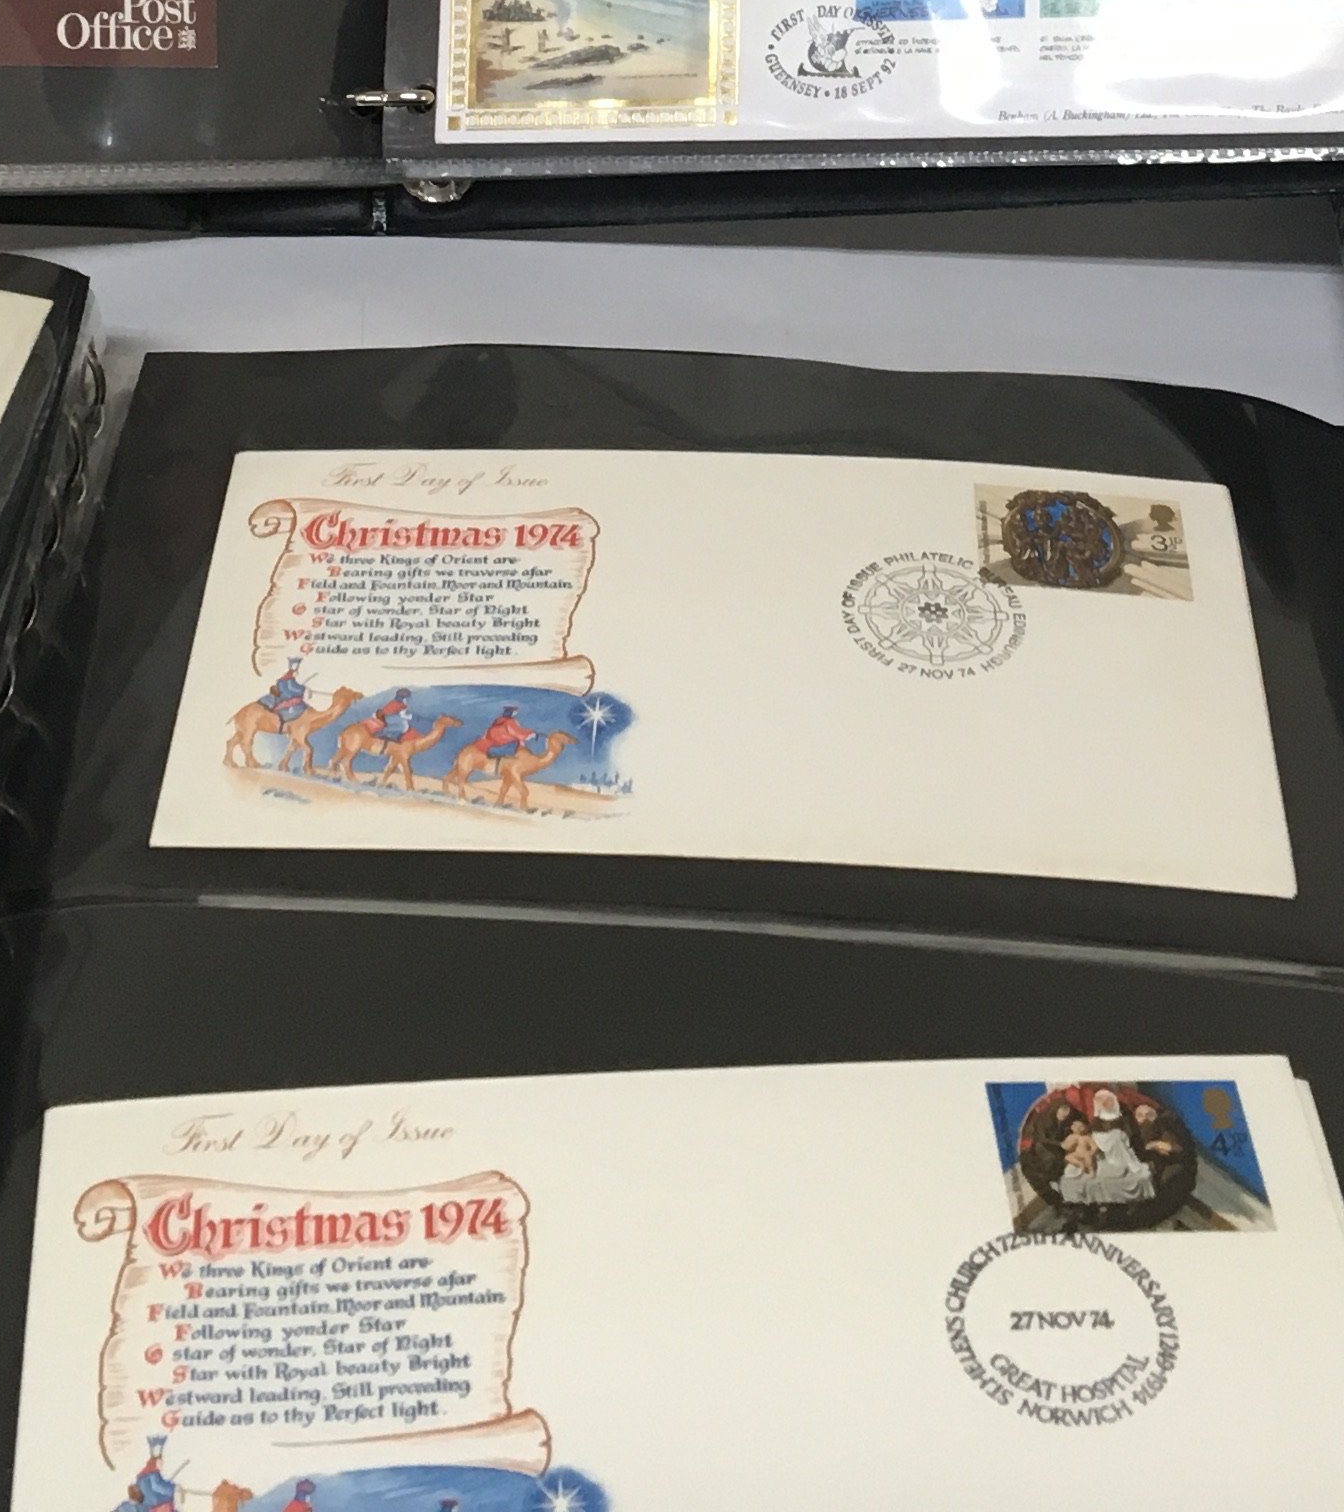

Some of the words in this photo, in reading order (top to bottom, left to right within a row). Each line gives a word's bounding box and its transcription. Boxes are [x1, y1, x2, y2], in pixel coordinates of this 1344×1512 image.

[57, 13, 173, 50] Office
[771, 8, 805, 41] FIRST
[818, 6, 841, 18] DAY
[765, 52, 822, 99] GUERNSEY
[835, 85, 848, 99] 18
[851, 71, 883, 96] SEPT
[321, 462, 385, 488] First
[394, 463, 452, 494] Day
[457, 472, 485, 495] of
[493, 465, 549, 487] Issue
[302, 510, 504, 551] Christmas
[516, 523, 582, 547] 1974
[883, 552, 974, 570] PHILATELIC
[850, 562, 882, 592] ISSUE
[841, 591, 857, 608] OF
[841, 610, 861, 635] DAY
[854, 637, 894, 667] FIRST
[897, 663, 917, 674] 27
[920, 669, 954, 679] NOV
[958, 667, 976, 677] 74
[163, 1112, 243, 1155] First
[257, 1110, 330, 1162] Day
[339, 1119, 373, 1160] of
[381, 1108, 454, 1142] Issue
[145, 1192, 411, 1255] Christmas
[421, 1197, 506, 1239] 1974
[159, 1261, 192, 1279] We
[200, 1263, 244, 1278] three
[252, 1261, 304, 1278] Kings
[310, 1258, 326, 1276] of
[332, 1256, 392, 1273] Orient
[399, 1257, 433, 1270] are
[945, 1241, 1001, 1313] CHURCH
[1059, 1231, 1178, 1331] ANNIVERSARY
[184, 1282, 270, 1300] Bearing
[277, 1280, 320, 1301] gifts
[326, 1283, 350, 1292] we
[356, 1276, 433, 1291] traverse
[437, 1271, 476, 1290] afar
[148, 1304, 198, 1321] Field
[203, 1304, 237, 1318] and
[337, 1298, 382, 1316] Moor
[384, 1295, 415, 1310] and
[420, 1290, 506, 1310] Mountain
[1010, 1311, 1035, 1330] 27
[1038, 1311, 1087, 1329] NOV
[175, 1324, 272, 1342] Following
[281, 1320, 350, 1342] yonder
[359, 1317, 407, 1333] Star
[144, 1344, 163, 1364] O
[172, 1345, 213, 1361] star
[219, 1345, 236, 1362] of
[323, 1339, 365, 1355] Star
[371, 1342, 388, 1356] of
[396, 1334, 453, 1352] Night
[172, 1364, 218, 1384] Star
[225, 1366, 267, 1379] with
[274, 1362, 327, 1381] Royal
[336, 1360, 400, 1375] beauty
[409, 1354, 471, 1374] Bright
[990, 1353, 1056, 1401] GREAT
[1062, 1354, 1150, 1403] HOSPITAL
[137, 1388, 242, 1407] Westward
[332, 1381, 373, 1400] Still
[161, 1409, 225, 1432] Guide
[261, 1411, 278, 1424] to
[284, 1408, 315, 1427] thy
[324, 1405, 384, 1422] Perfect
[1017, 1399, 1133, 1426] NORWICH
